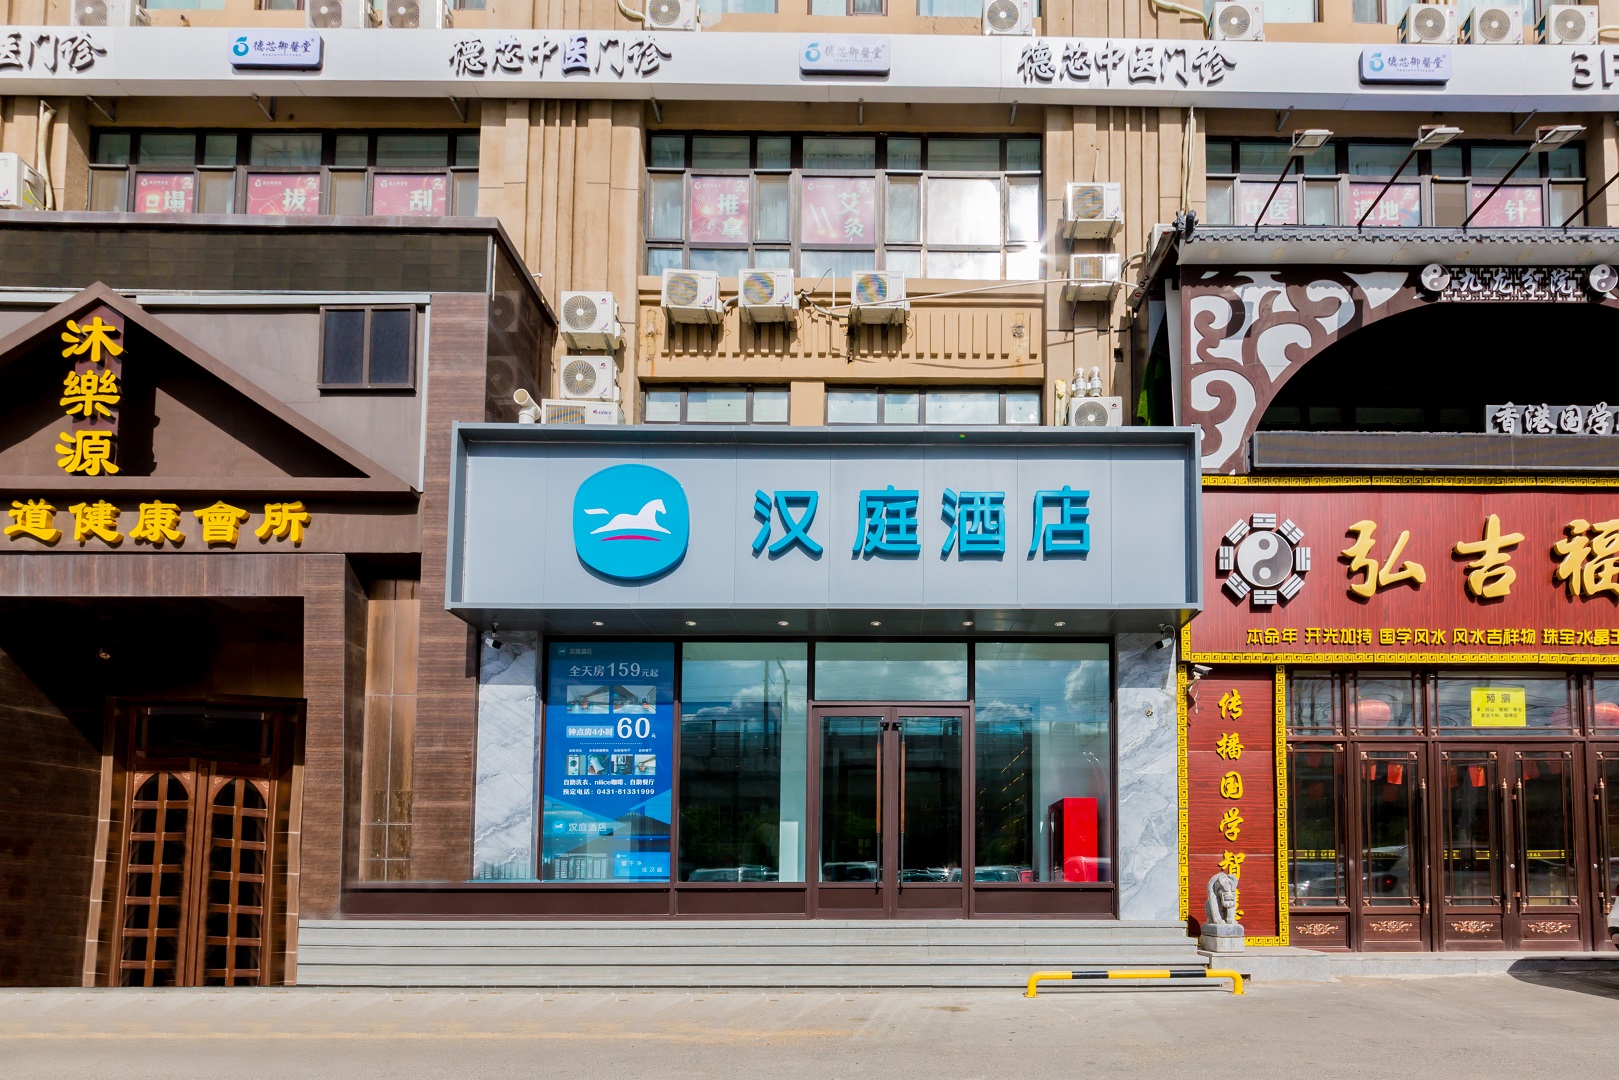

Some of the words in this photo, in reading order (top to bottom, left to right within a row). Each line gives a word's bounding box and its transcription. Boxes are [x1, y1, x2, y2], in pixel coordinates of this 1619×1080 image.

[449, 36, 672, 79] 德芯中医门诊
[1017, 39, 1237, 87] 德芯中医门诊
[282, 187, 307, 215] 拔
[409, 189, 433, 216] 刮
[717, 193, 744, 239] 推拿
[836, 192, 865, 239] 艾灸
[1505, 199, 1528, 226] 针
[55, 316, 124, 476] 沐樂源
[4, 499, 312, 545] 道健康會所
[752, 485, 1091, 562] 汉庭酒店
[1341, 513, 1619, 599] 弘吉福
[1246, 628, 1298, 645] 本命年
[1305, 628, 1373, 645] 开光加持
[1379, 628, 1447, 645] 国学风水
[1452, 628, 1536, 646] 风水吉祥物
[568, 728, 613, 736] 钟点房4小时
[568, 822, 607, 832] 汉庭酒店
[1216, 688, 1247, 921] 传播国学智
